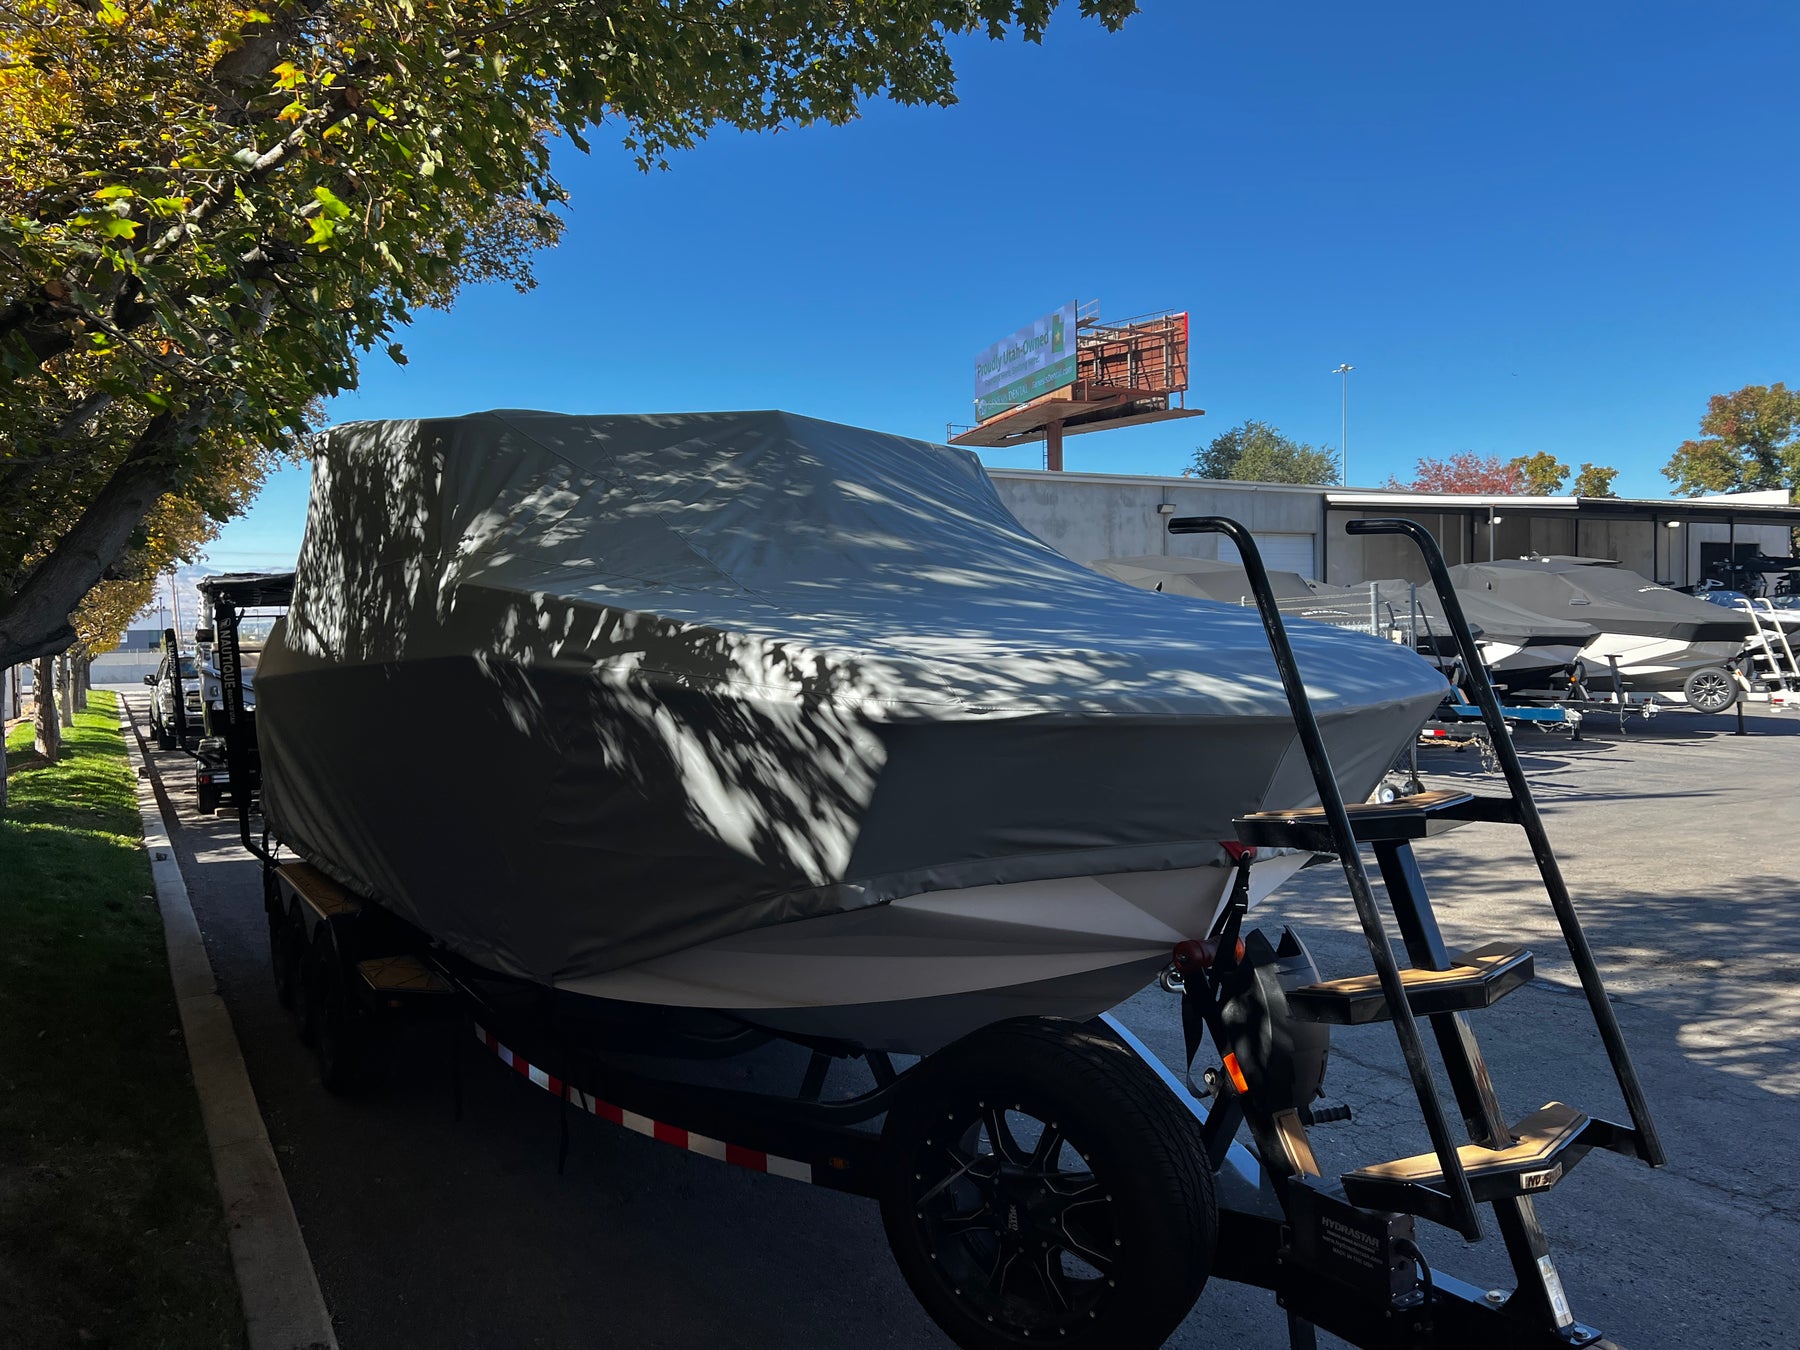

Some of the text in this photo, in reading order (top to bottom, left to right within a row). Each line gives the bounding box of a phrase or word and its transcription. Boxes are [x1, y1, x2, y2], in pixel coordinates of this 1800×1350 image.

[977, 356, 1002, 378] Proudly
[1003, 327, 1049, 364] Utah-Owned
[220, 630, 236, 688] NAUTIQUE
[1322, 1216, 1379, 1248] HYDRASTAR
